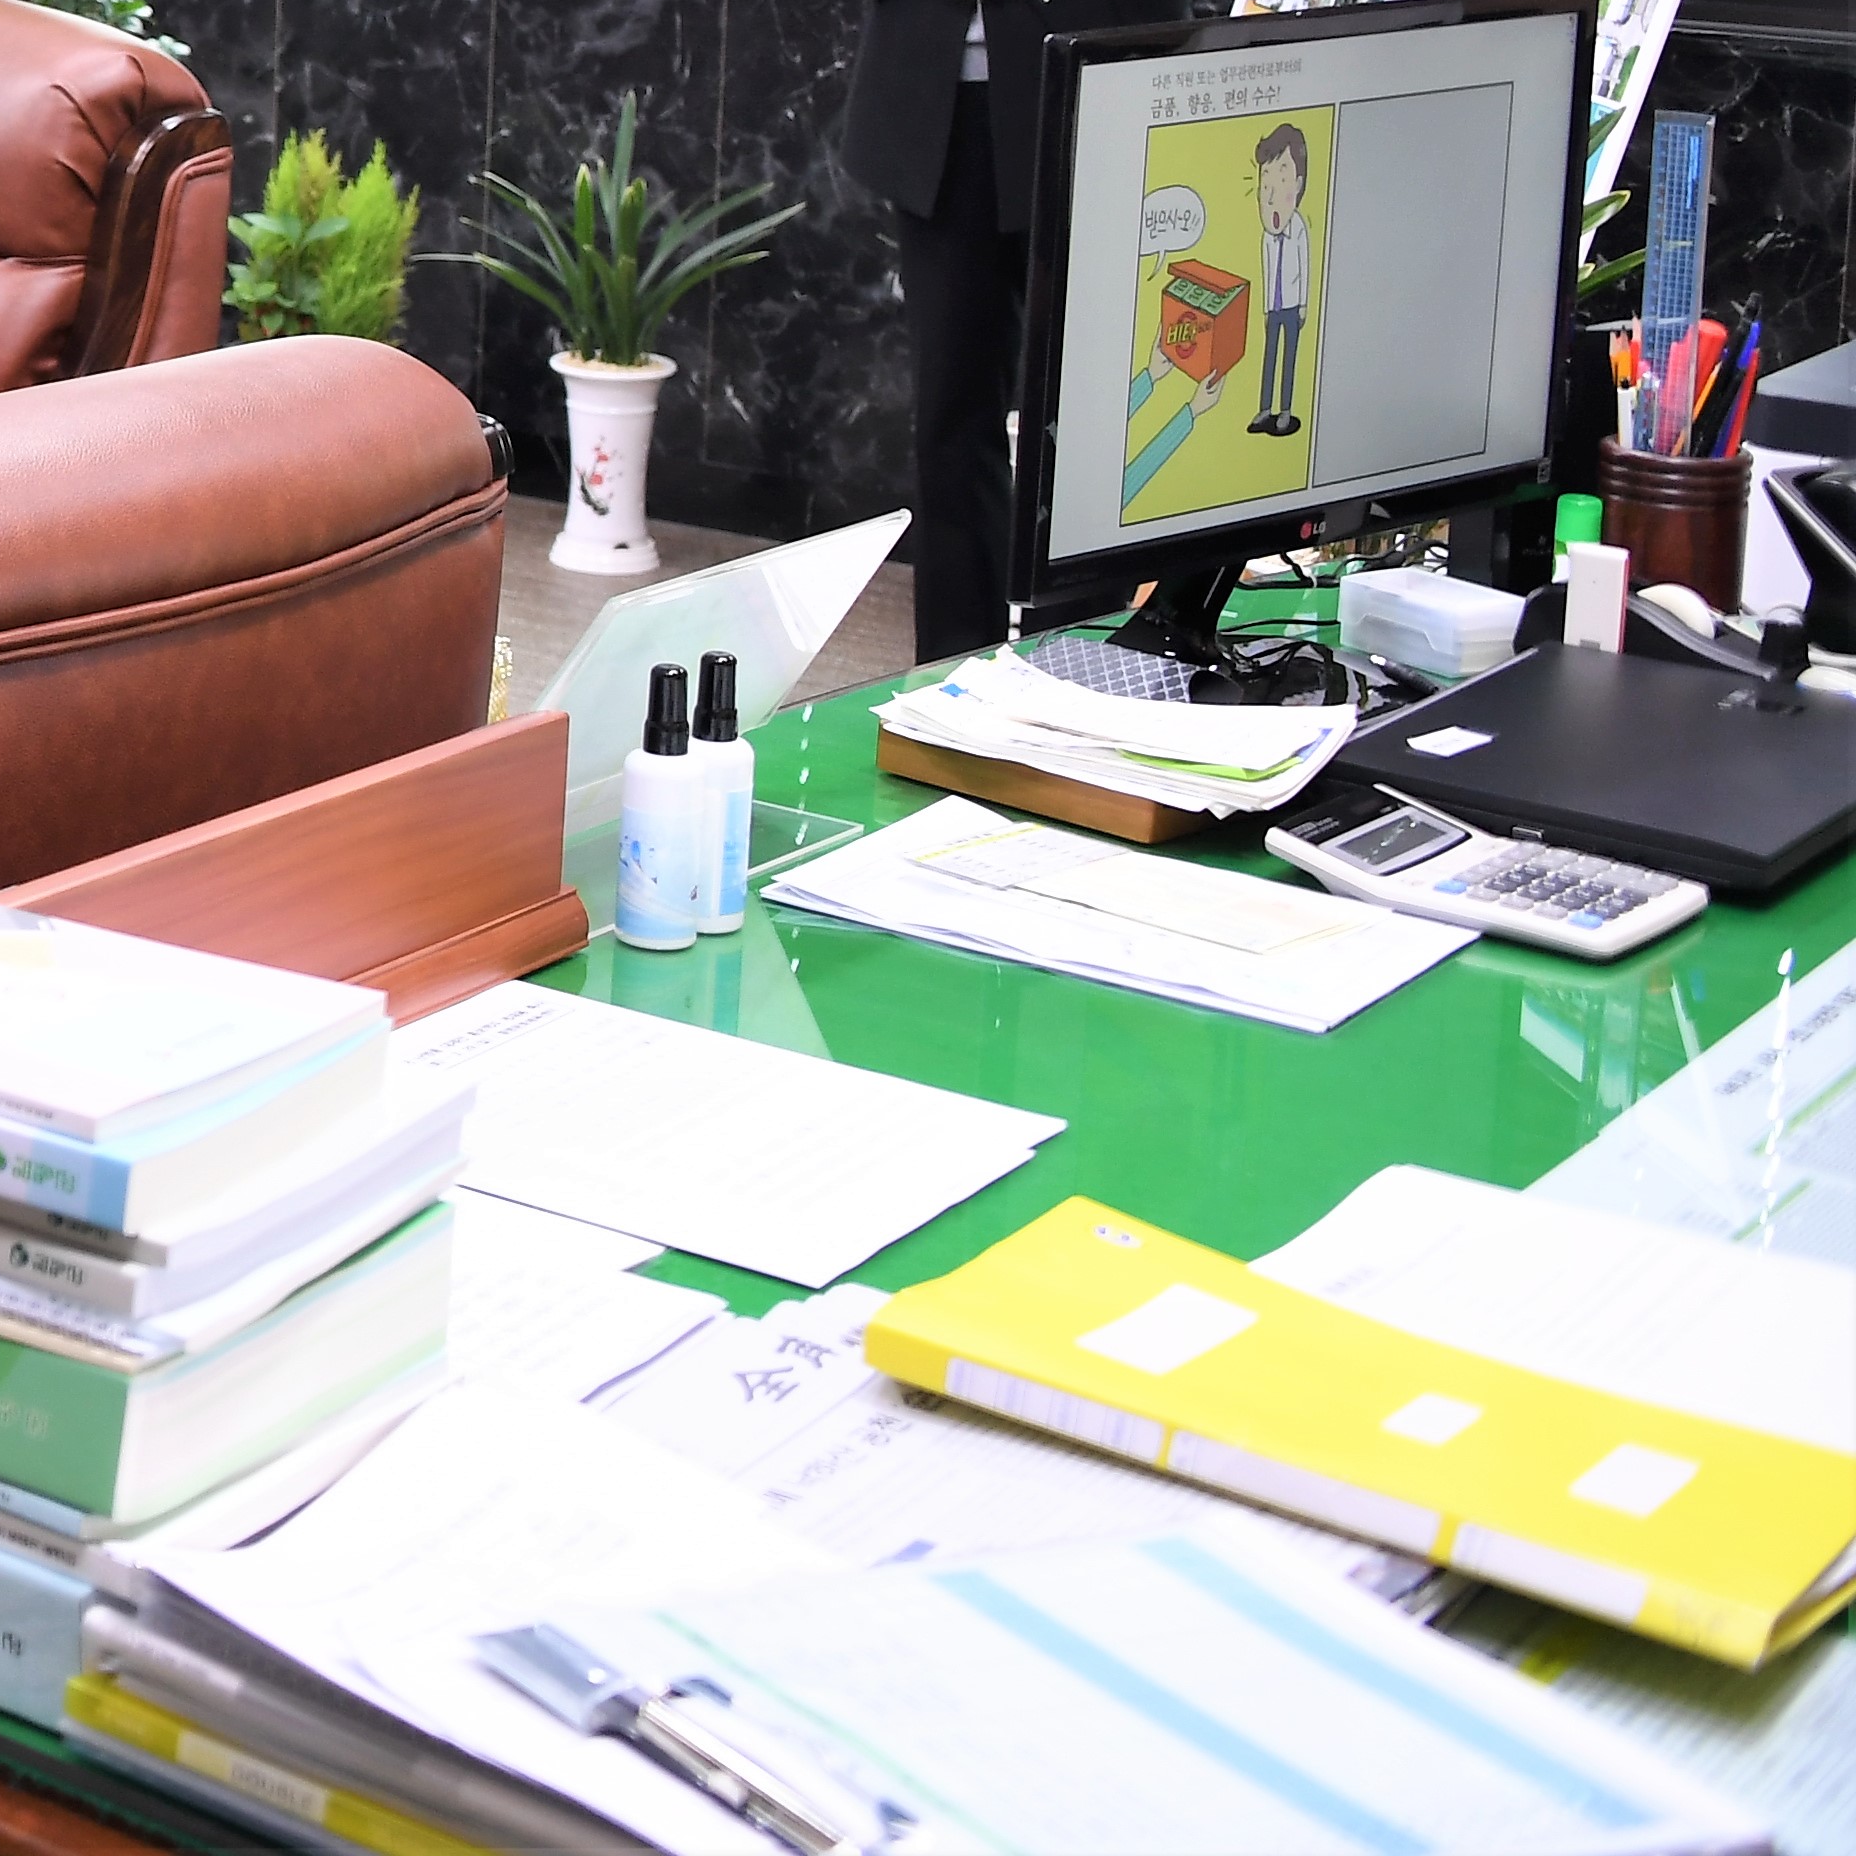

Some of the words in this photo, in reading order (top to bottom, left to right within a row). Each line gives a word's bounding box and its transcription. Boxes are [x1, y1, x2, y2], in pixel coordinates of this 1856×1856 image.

[1152, 74, 1172, 90] 다른
[1197, 70, 1216, 84] 또는
[1151, 97, 1180, 119] 금품,
[1188, 93, 1216, 115] 향응,
[1224, 88, 1248, 110] 편의
[1252, 85, 1281, 106] 수수!
[1313, 520, 1326, 534] LG
